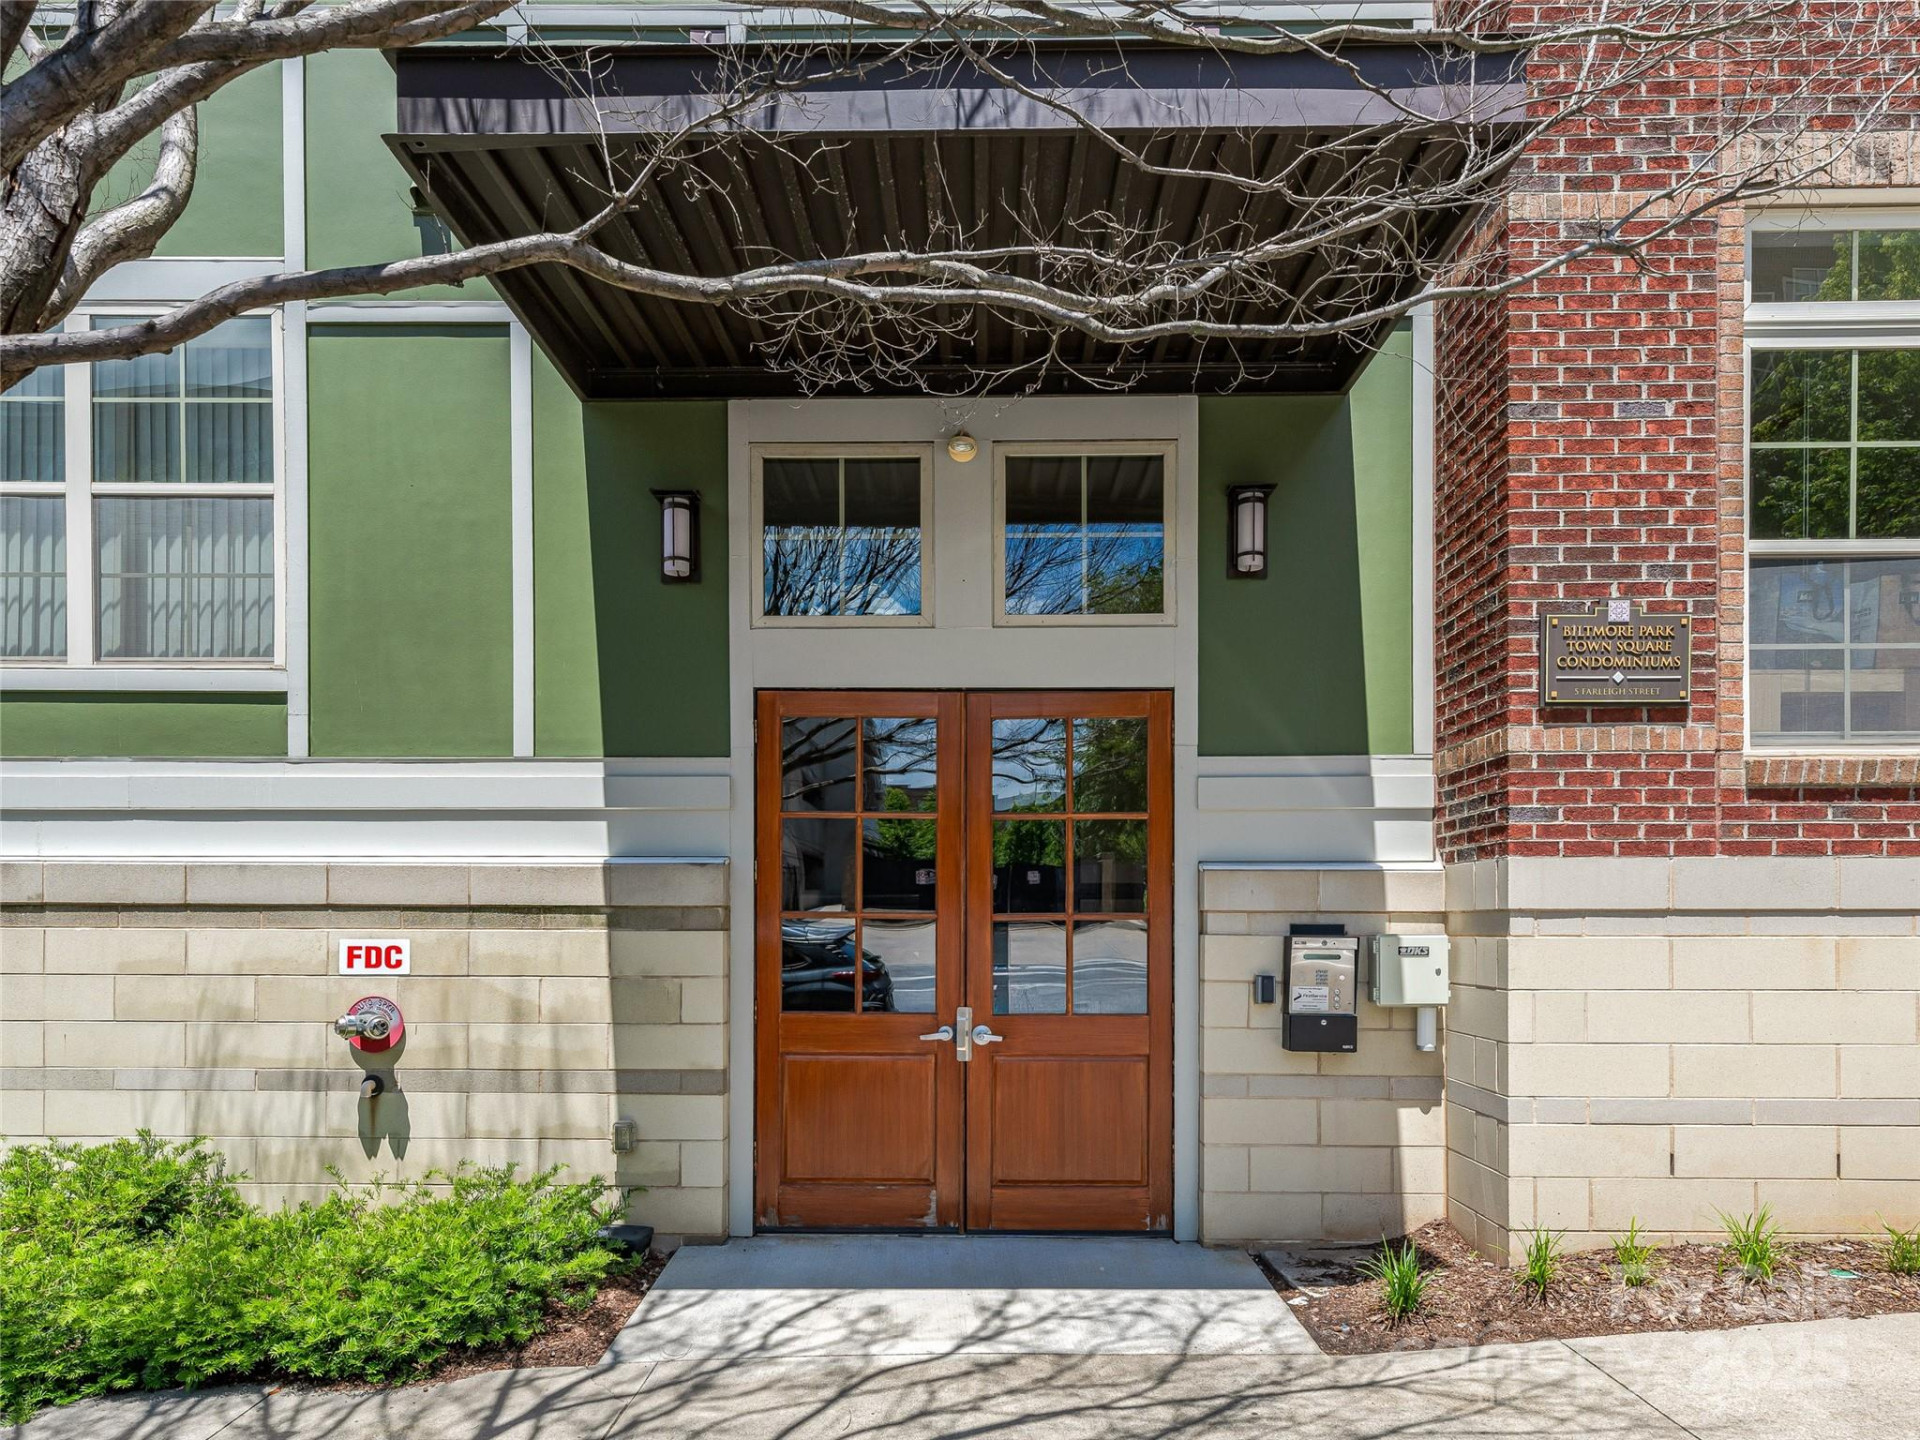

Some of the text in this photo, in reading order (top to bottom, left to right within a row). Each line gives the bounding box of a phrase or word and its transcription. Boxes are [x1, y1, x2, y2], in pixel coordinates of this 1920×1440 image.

[1562, 624, 1675, 638] BILTMORE PARK
[1566, 640, 1672, 655] TOWN SQUARE
[1556, 655, 1681, 669] CONDOMINIUMS
[1581, 687, 1626, 696] FARLEIGH
[1628, 687, 1661, 696] STREET
[346, 945, 403, 969] FDC
[1407, 946, 1429, 955] DKS
